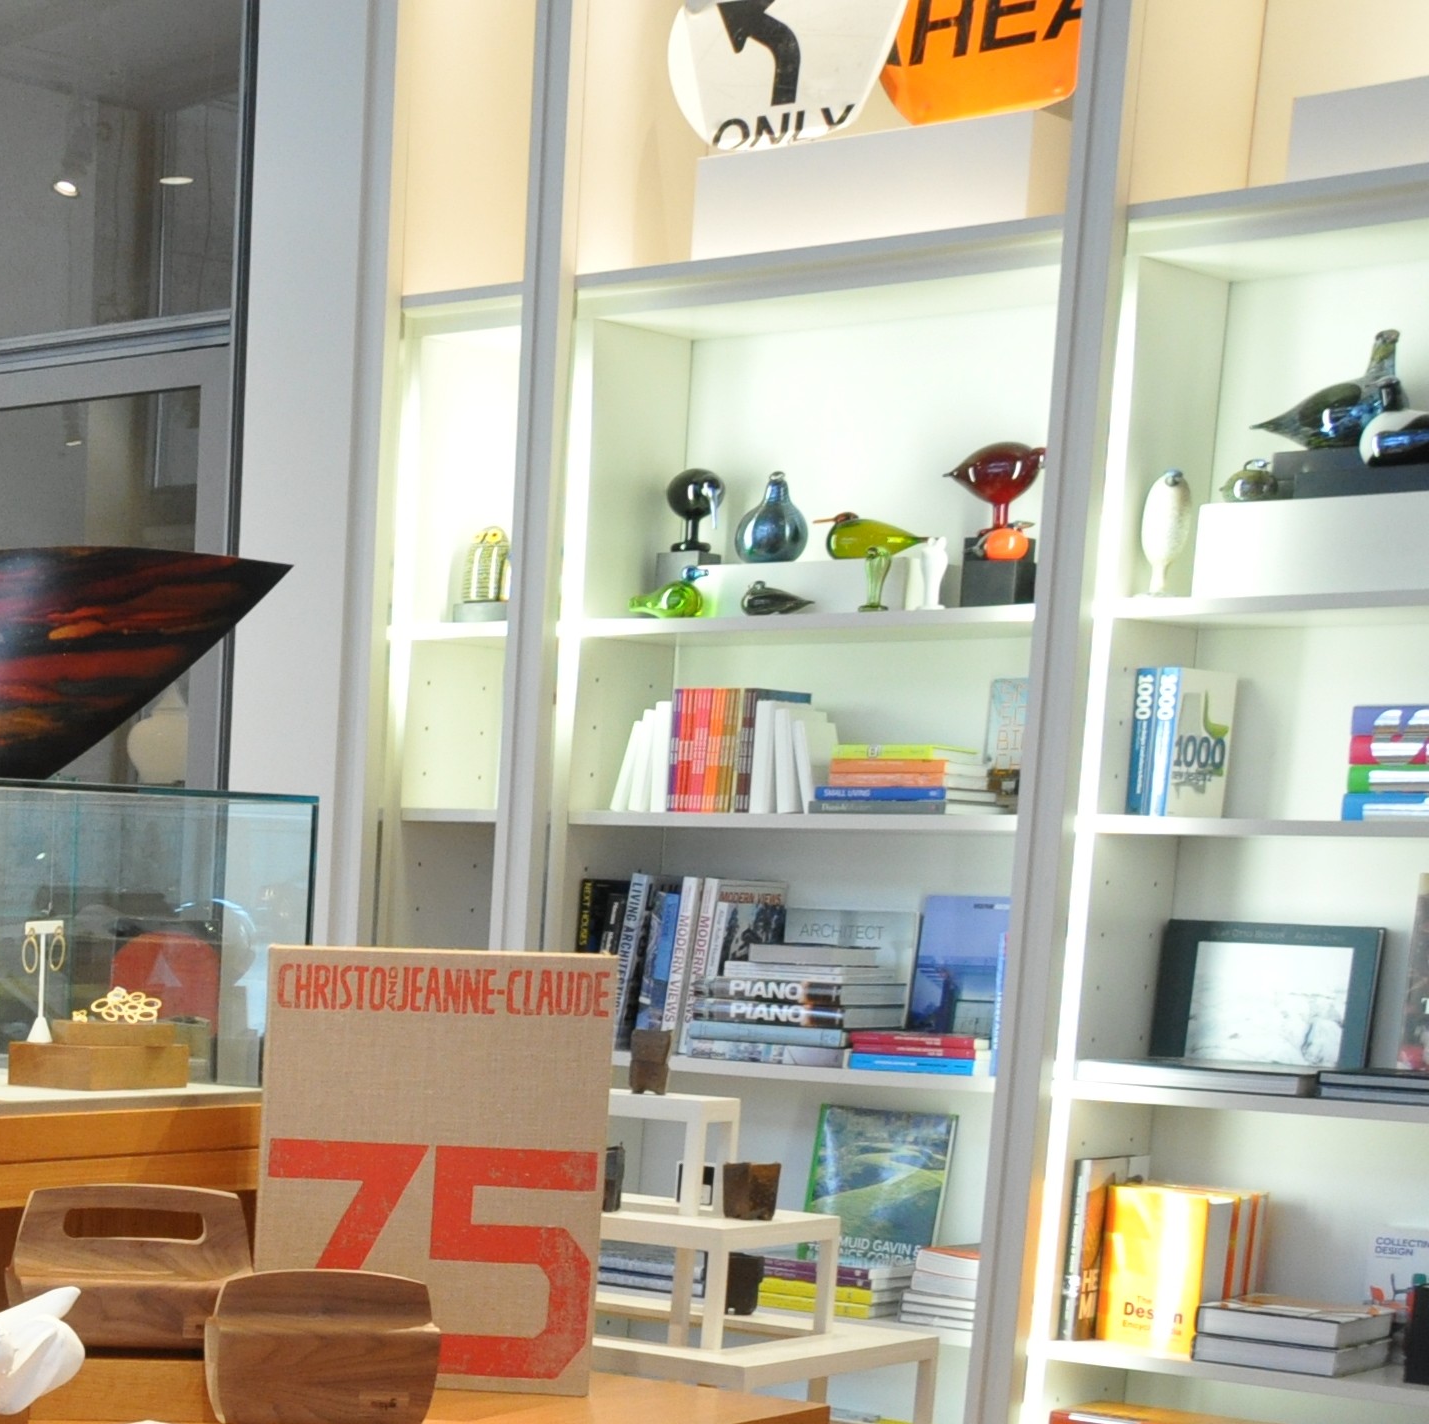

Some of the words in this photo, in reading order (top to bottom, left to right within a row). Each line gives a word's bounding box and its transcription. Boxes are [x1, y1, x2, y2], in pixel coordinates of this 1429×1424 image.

[712, 104, 855, 150] ONLY
[1135, 673, 1154, 720] 1000
[1157, 673, 1178, 721] 1000
[1173, 735, 1226, 769] 1000
[625, 882, 643, 923] LIVING
[720, 890, 754, 905] MODERN
[758, 891, 782, 905] VIEWS
[670, 914, 689, 980] MODERN
[692, 916, 710, 980] MODERN
[799, 922, 885, 941] ARCHITECT
[277, 962, 388, 1011] CHRISTO
[396, 966, 611, 1017] JEANNE-CLAUDE
[664, 982, 682, 1023] VIEWS
[729, 979, 804, 1000] PIANO
[729, 1001, 805, 1023] PIANO
[268, 1138, 599, 1380] 75
[872, 1240, 909, 1255] GAVIN
[1374, 1246, 1413, 1256] DESIGN
[1375, 1236, 1429, 1248] COLLECTIN
[1123, 1301, 1183, 1325] Desn
